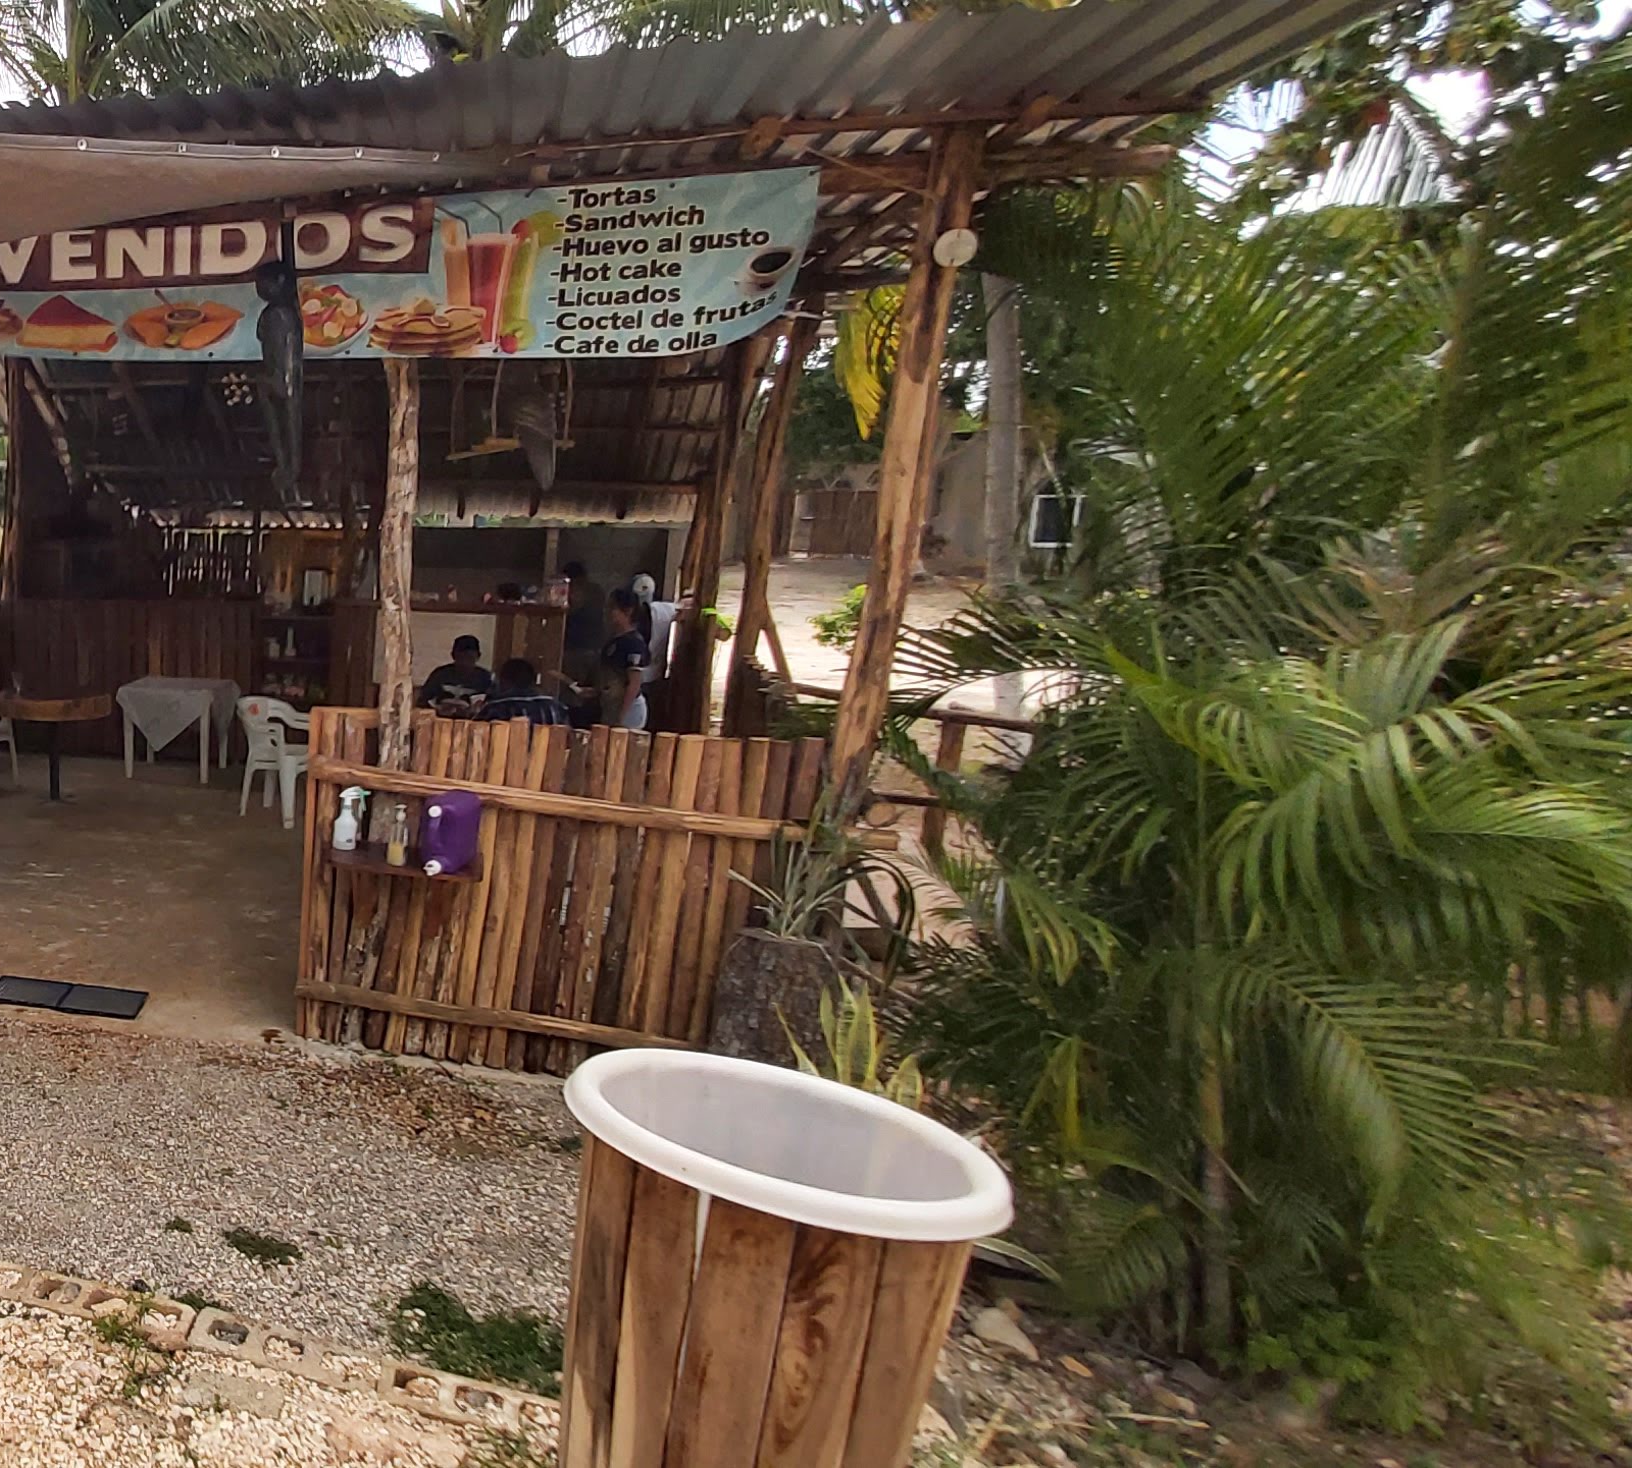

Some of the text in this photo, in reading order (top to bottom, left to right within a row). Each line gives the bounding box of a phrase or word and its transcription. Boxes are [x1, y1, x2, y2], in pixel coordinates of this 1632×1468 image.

[556, 186, 656, 209] -Tortas
[554, 205, 705, 233] -Sandwich
[552, 228, 770, 257] -Huevo al gusto
[550, 259, 682, 283] -Hot cake
[548, 284, 681, 307] -Licuados
[546, 291, 777, 330] -Coctel de frutas
[544, 331, 717, 354] -Cafe de olla
